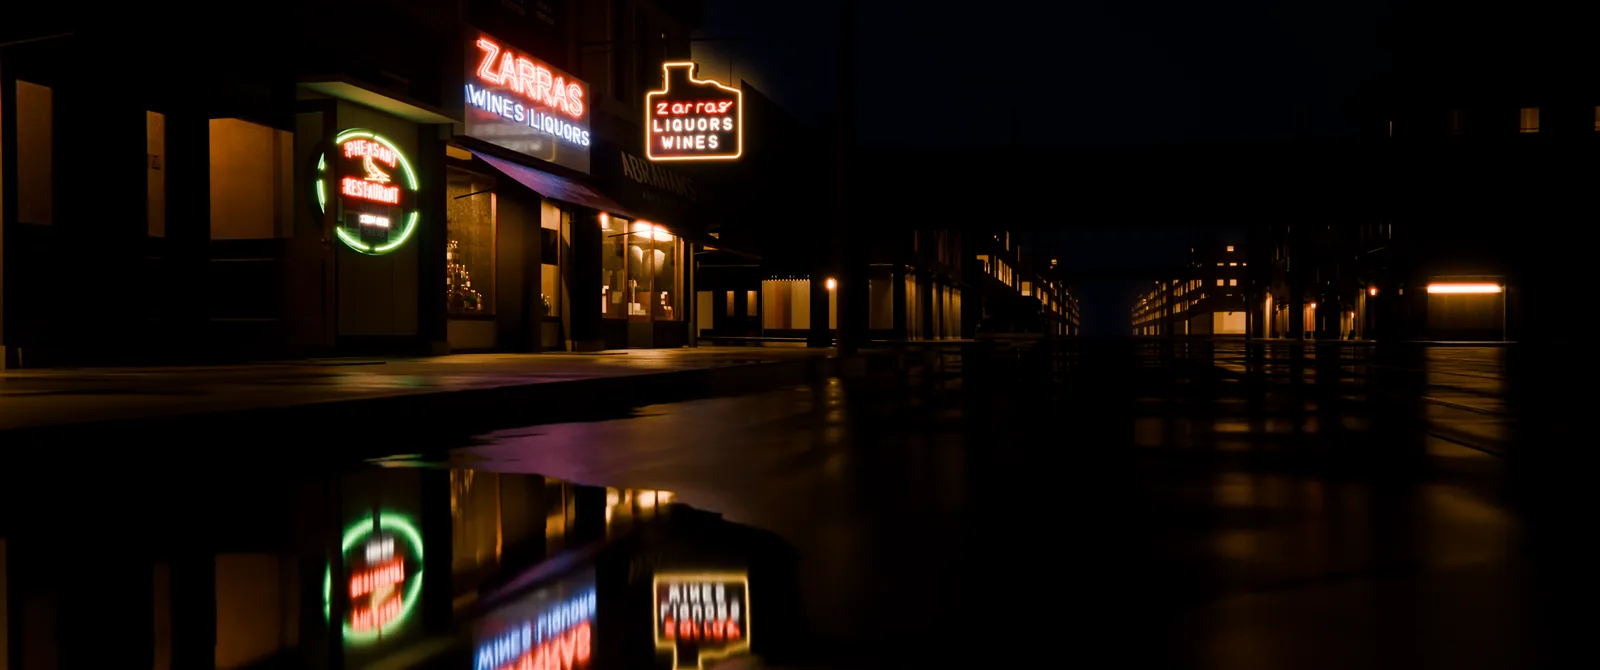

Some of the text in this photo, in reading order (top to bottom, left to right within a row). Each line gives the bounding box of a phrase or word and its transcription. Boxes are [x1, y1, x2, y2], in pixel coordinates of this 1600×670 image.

[476, 38, 584, 118] ZARRAS
[465, 83, 590, 147] WINES LIQUORS
[656, 101, 733, 115] zarras
[653, 117, 734, 133] LIQUORS
[343, 139, 399, 168] PHEASANT
[661, 134, 719, 150] WINES
[342, 177, 399, 205] RESTAURANT
